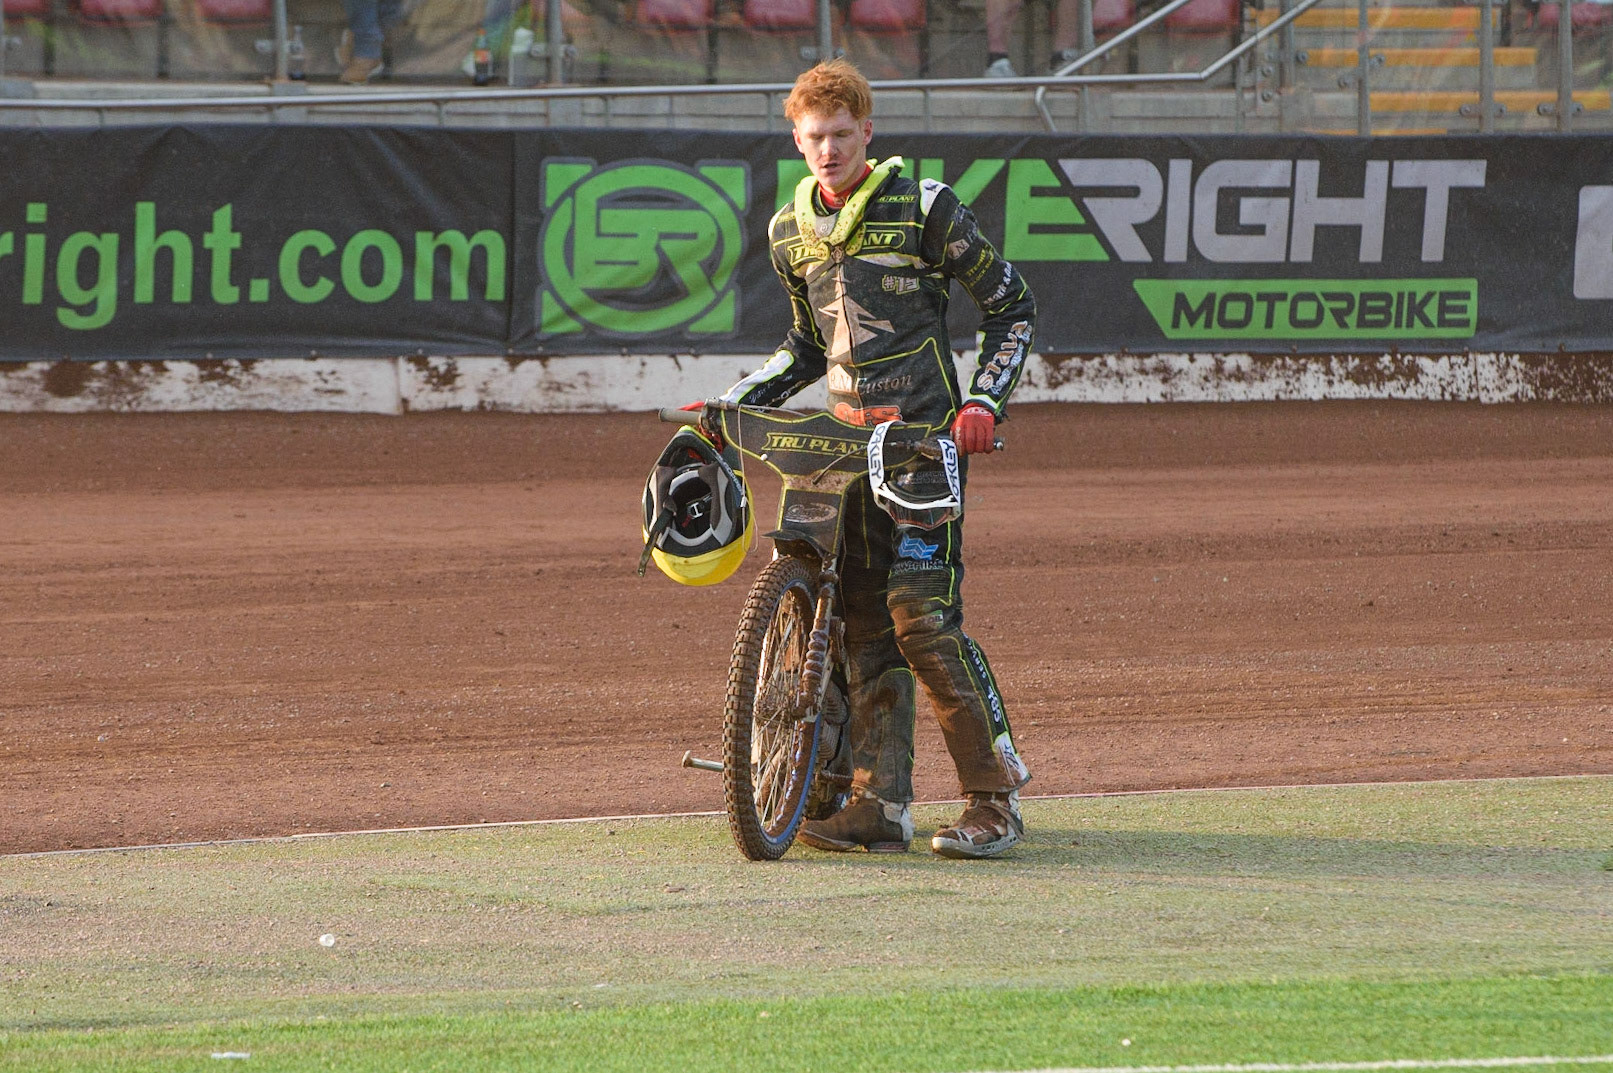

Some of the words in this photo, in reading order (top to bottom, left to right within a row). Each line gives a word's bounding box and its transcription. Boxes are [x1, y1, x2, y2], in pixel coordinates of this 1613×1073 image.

[1170, 290, 1471, 330] MOTORBIKE
[770, 435, 807, 450] TRU
[868, 424, 886, 480] OAKLEY
[942, 440, 961, 497] OAKLEY
